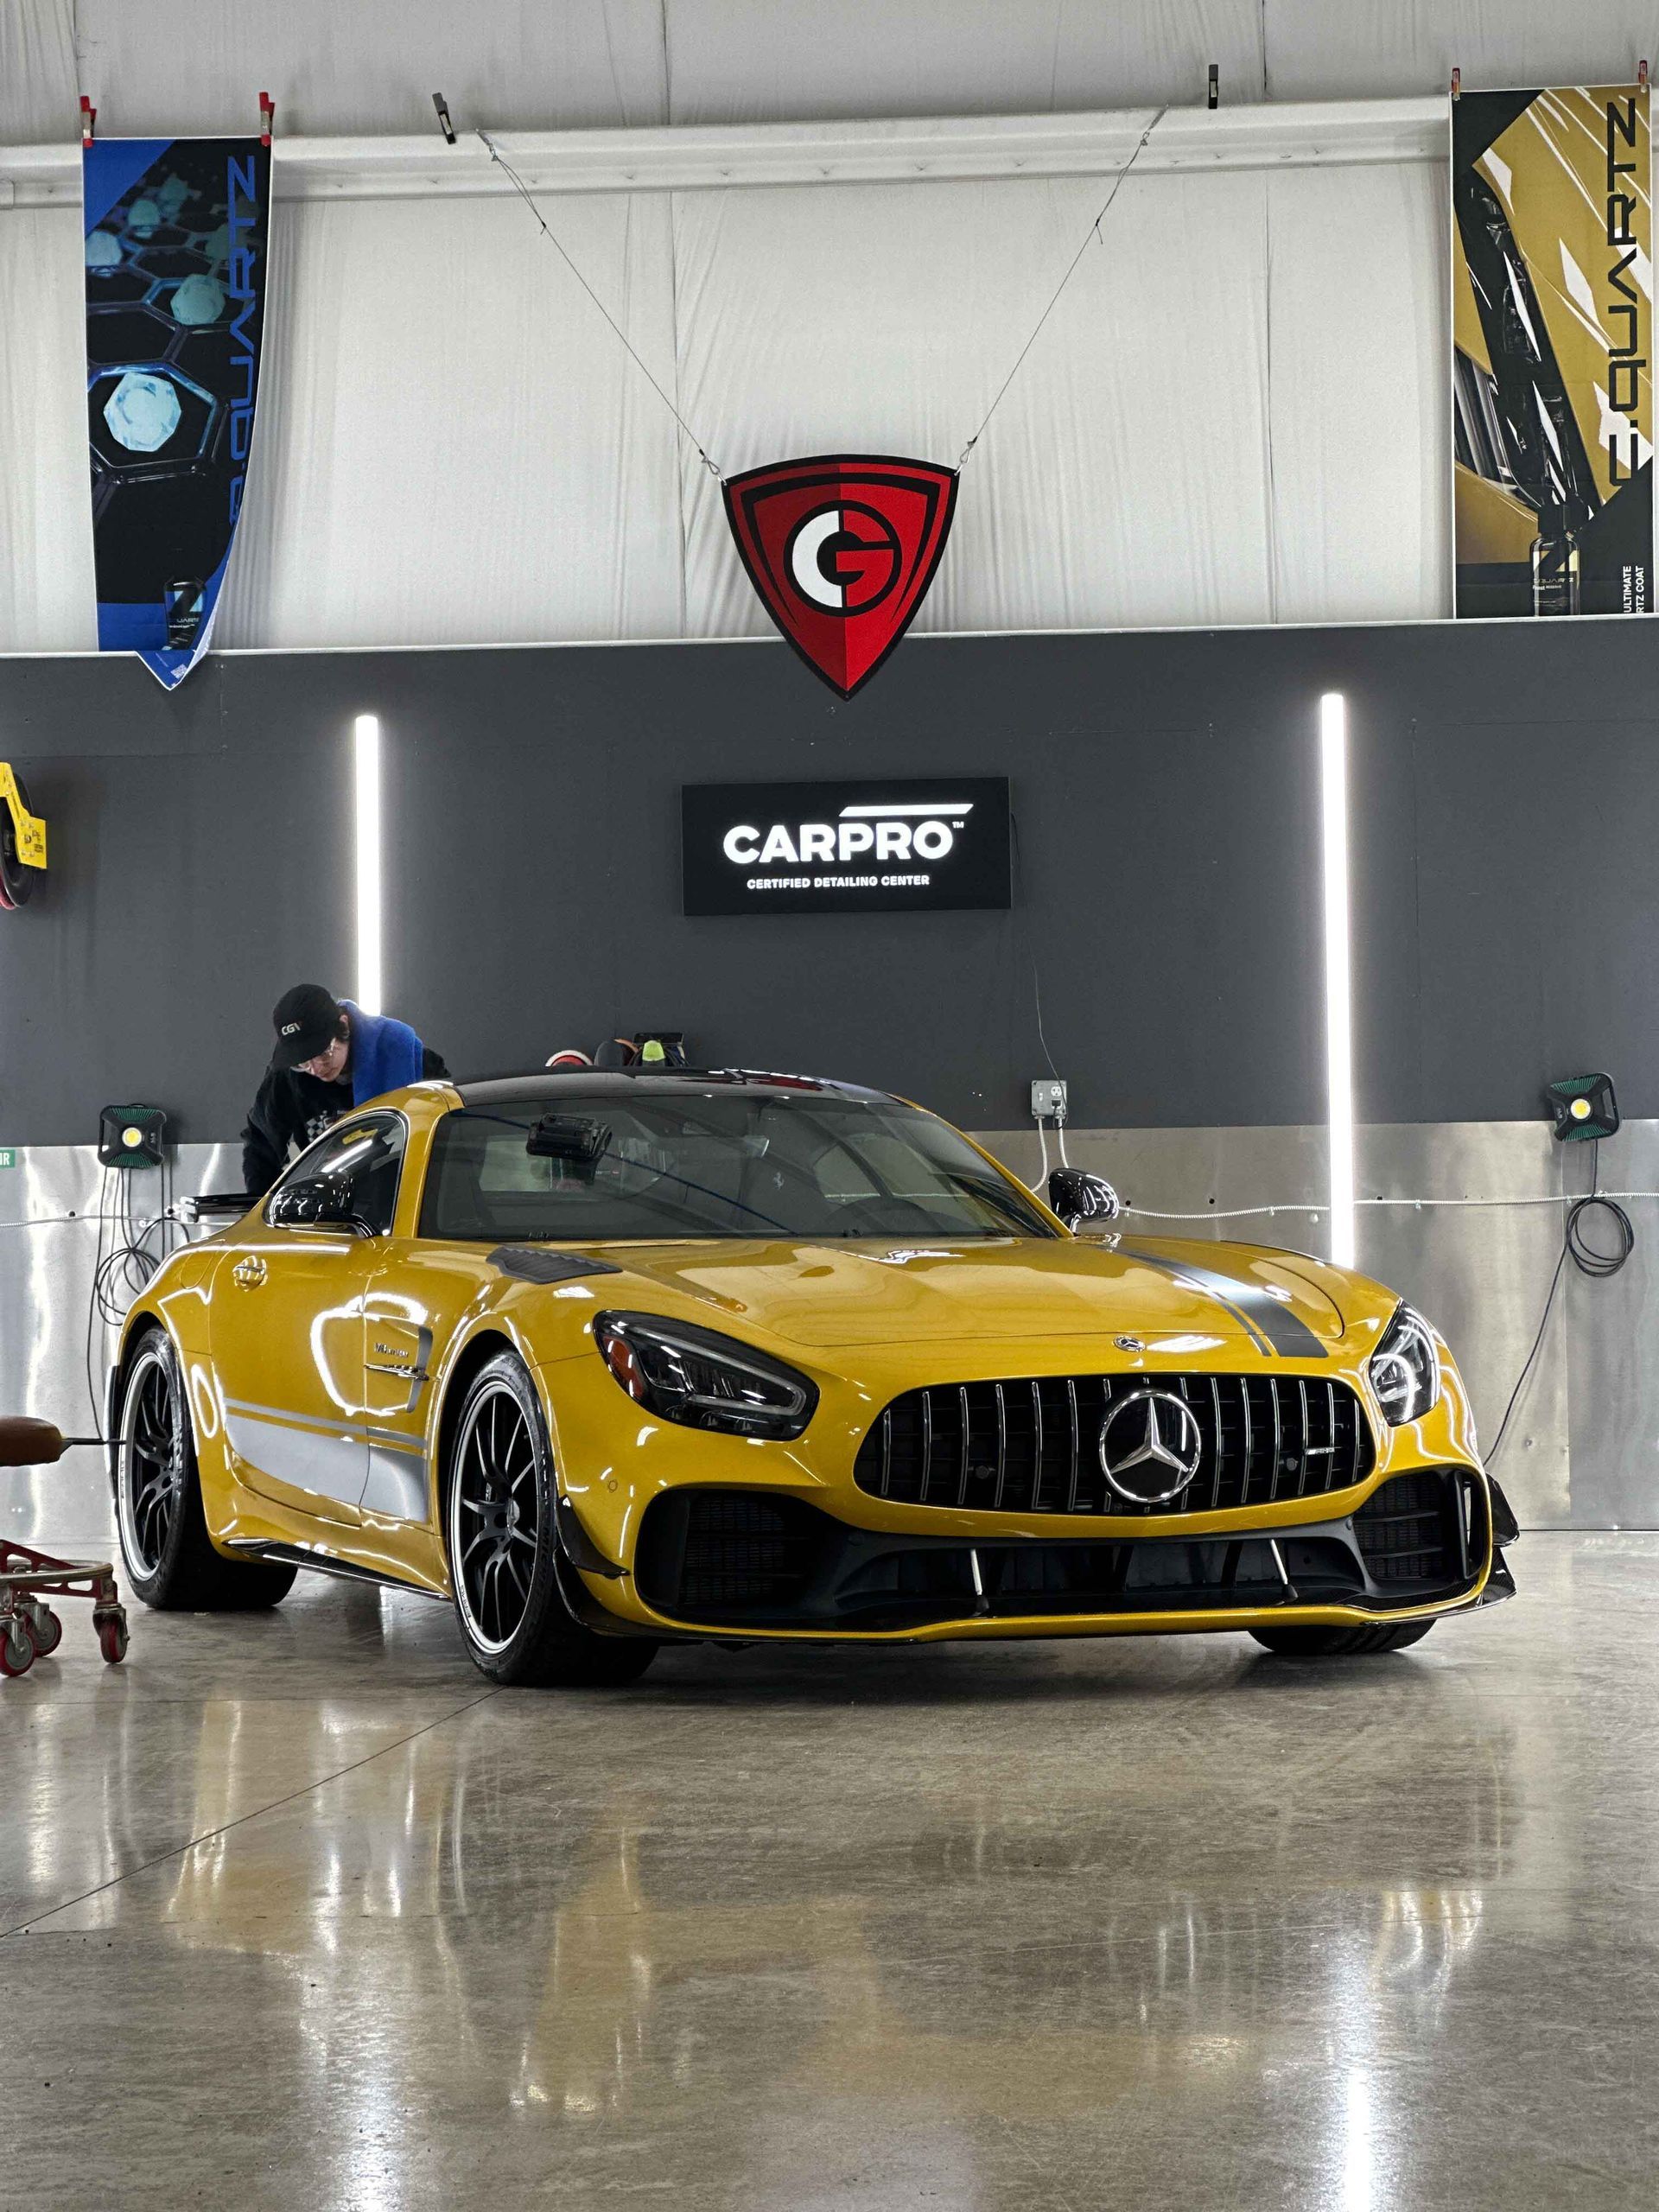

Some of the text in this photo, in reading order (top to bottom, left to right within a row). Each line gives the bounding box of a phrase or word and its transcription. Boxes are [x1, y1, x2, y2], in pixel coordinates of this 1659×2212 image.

[1623, 565, 1632, 613] ULTIMATE
[1636, 565, 1645, 593] COAT
[747, 874, 930, 889] CERTIFIED DETAILING CENTER
